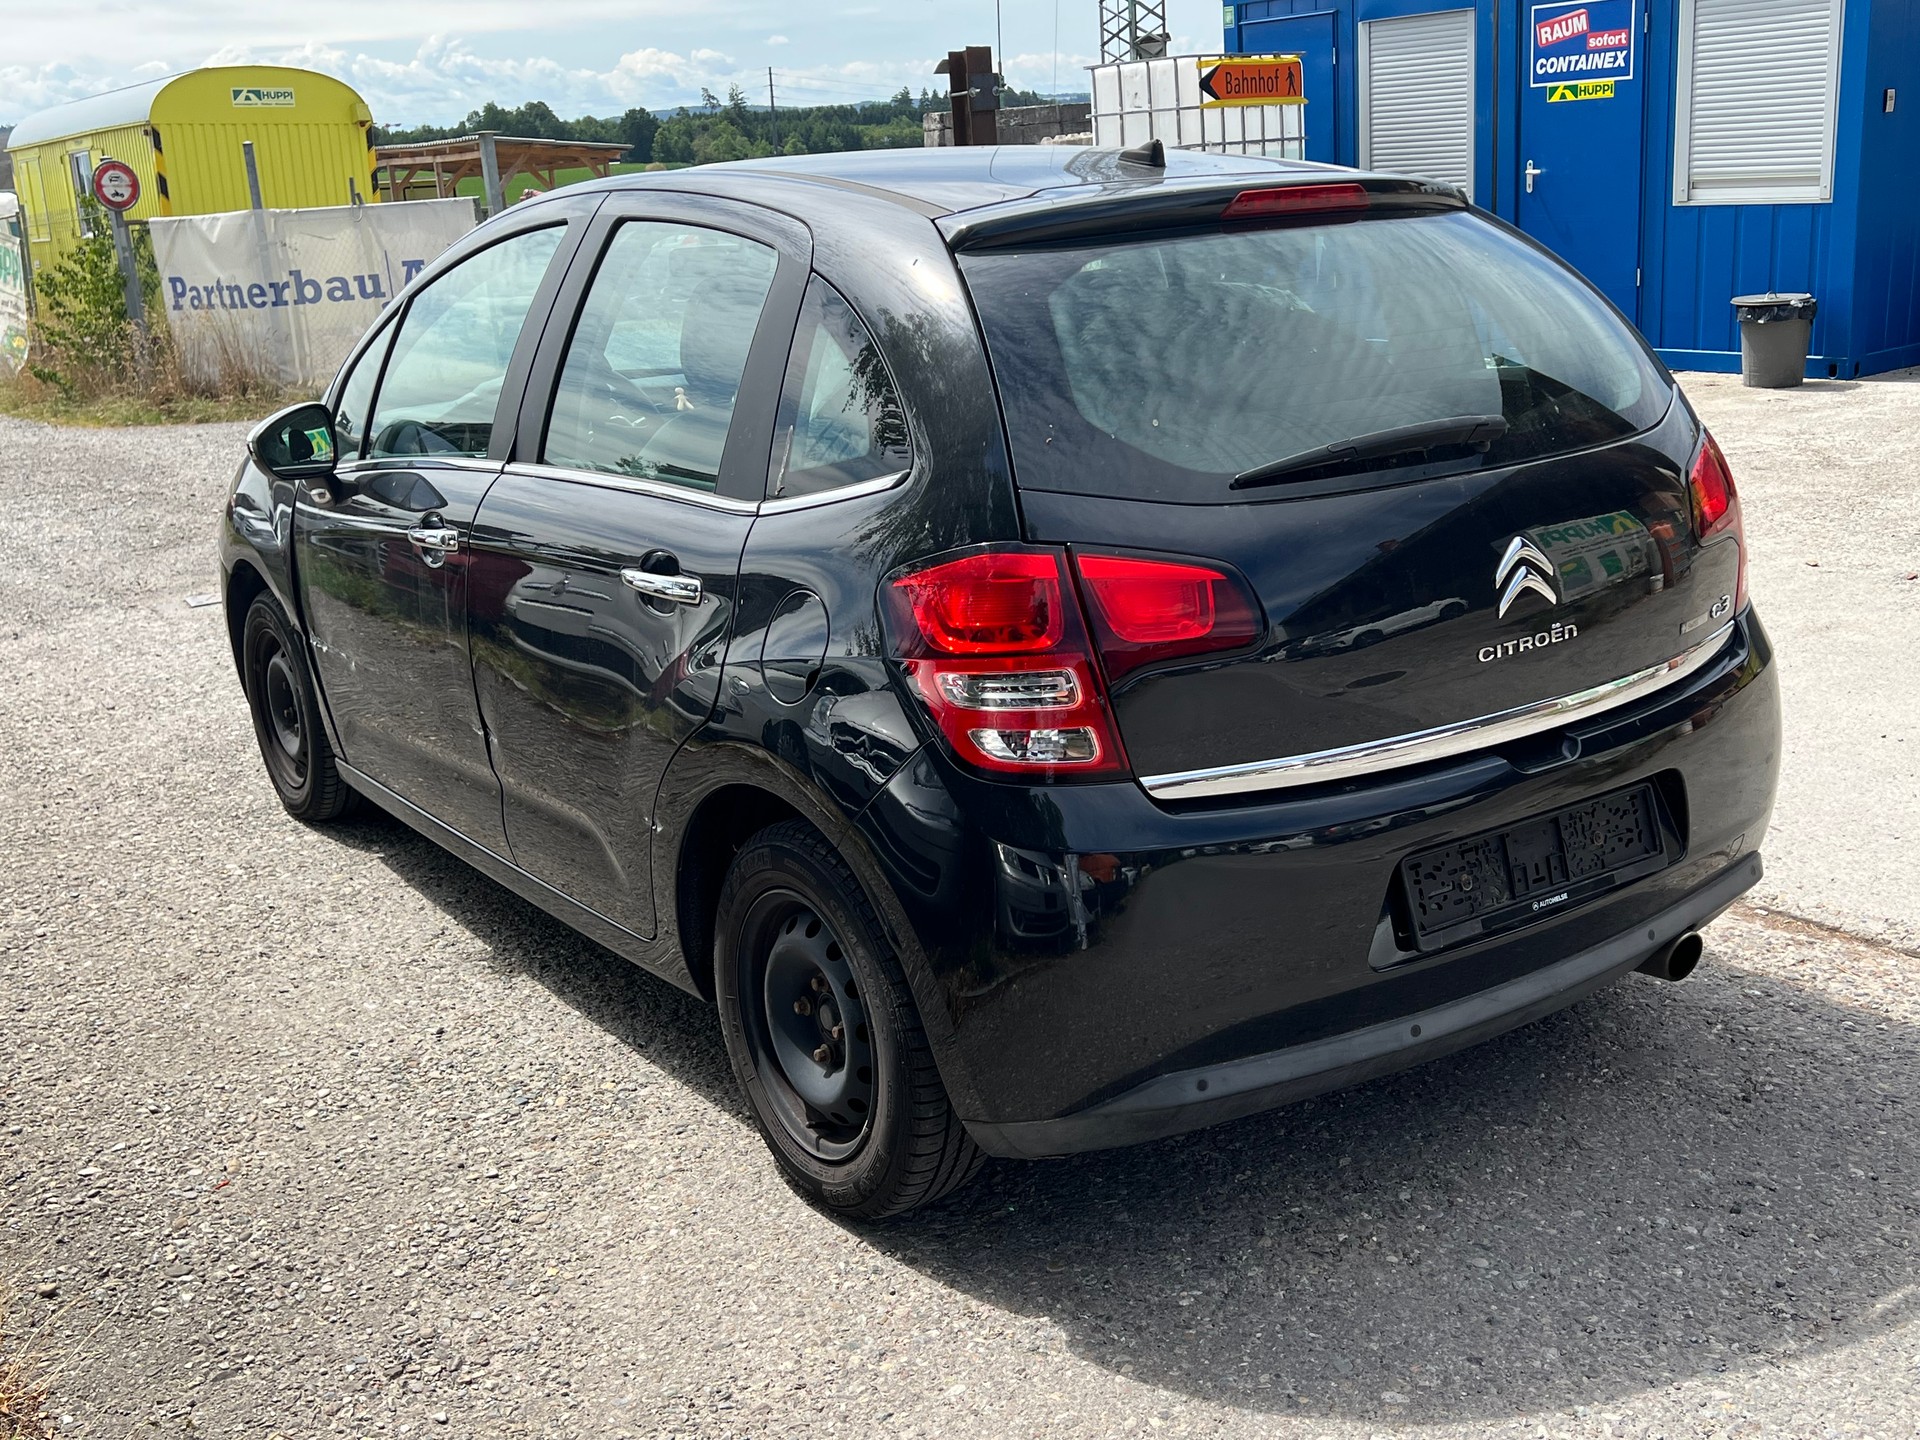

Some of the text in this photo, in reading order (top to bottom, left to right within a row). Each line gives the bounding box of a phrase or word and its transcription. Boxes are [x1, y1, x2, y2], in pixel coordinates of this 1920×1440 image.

[1540, 14, 1588, 44] RAUM
[1588, 32, 1627, 47] sofort
[1536, 50, 1628, 74] CONTAINEX
[1225, 68, 1280, 94] Bahnhof
[168, 269, 386, 311] Partnerbau
[1711, 594, 1731, 619] C3
